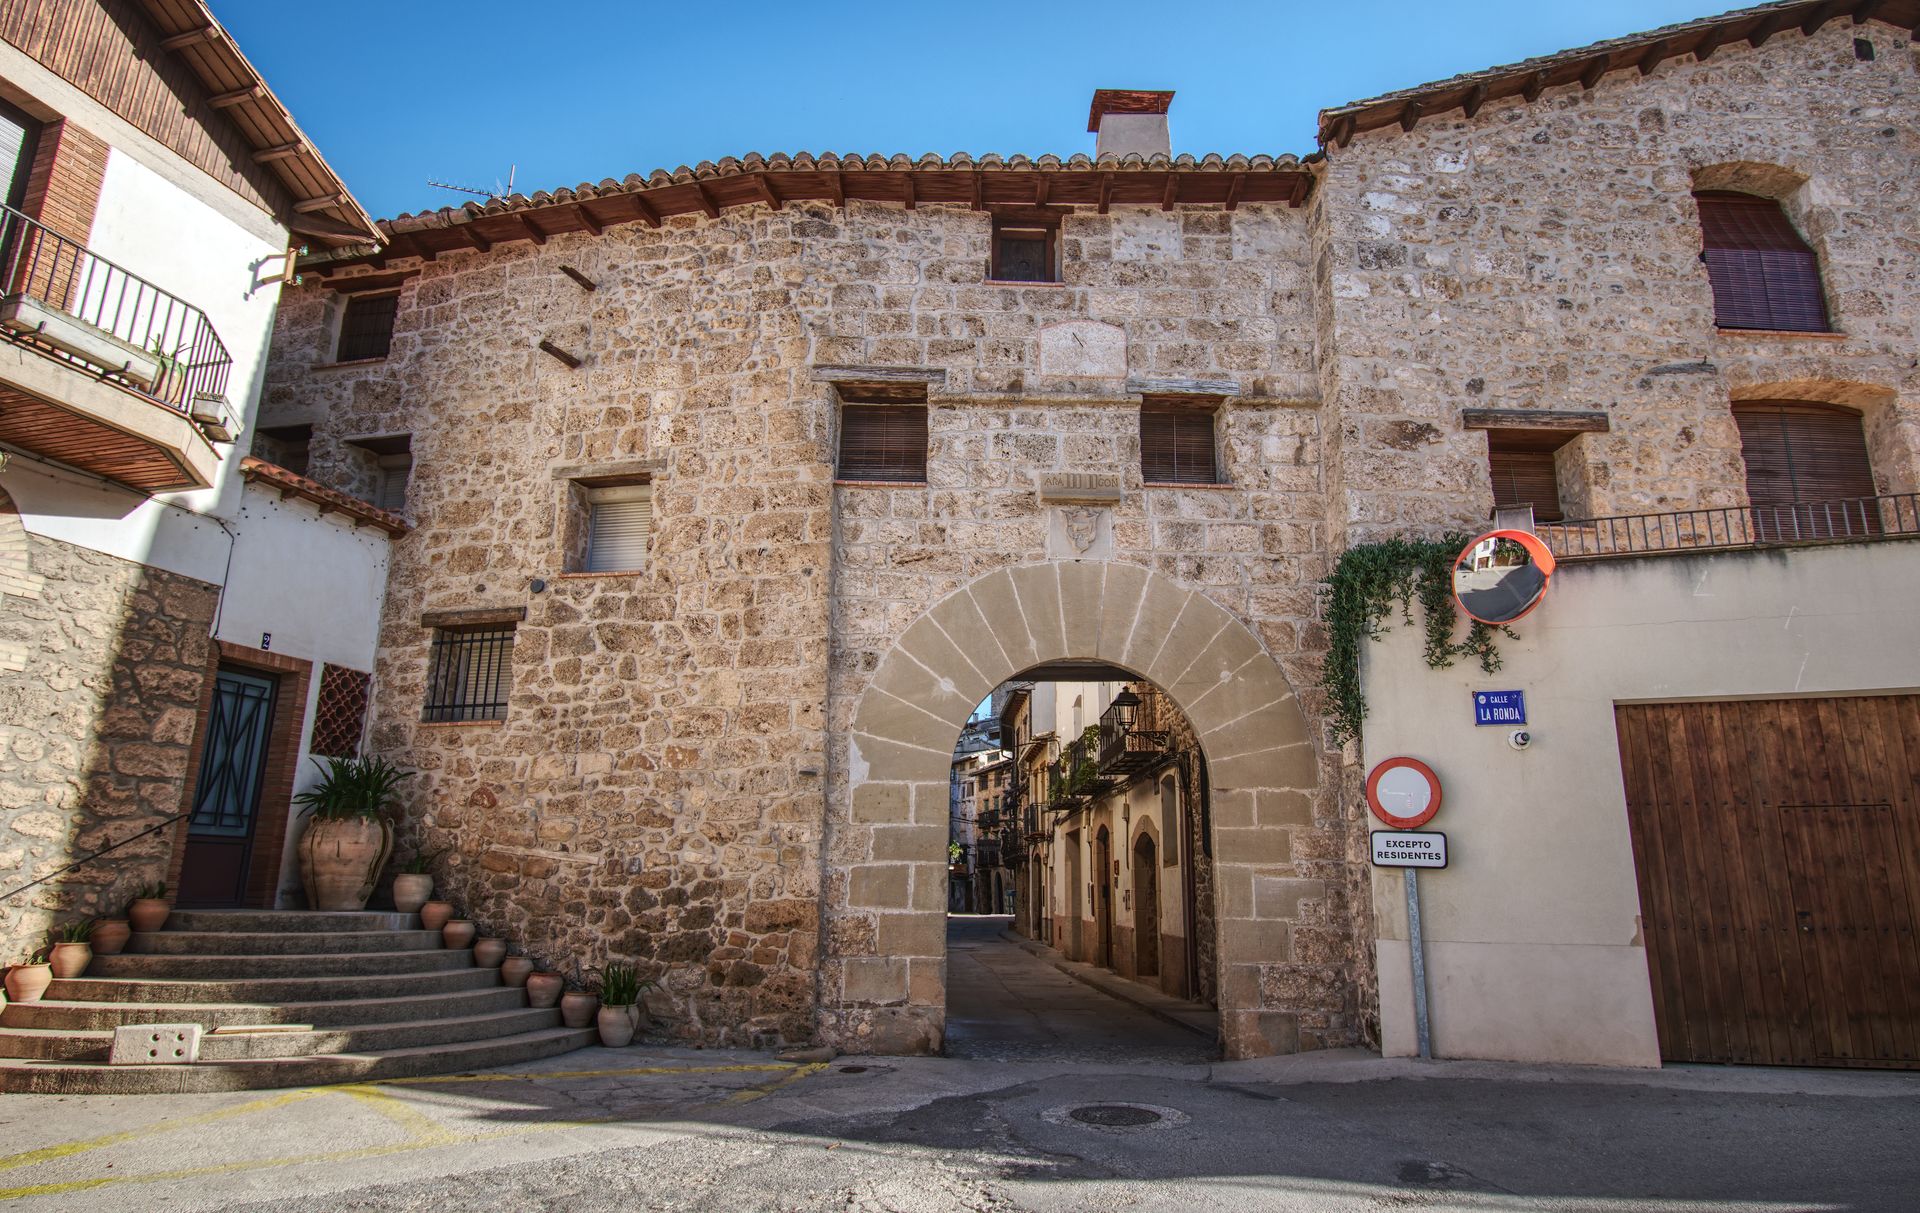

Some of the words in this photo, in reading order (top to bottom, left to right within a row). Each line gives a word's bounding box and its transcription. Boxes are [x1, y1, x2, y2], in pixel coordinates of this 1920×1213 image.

[263, 635, 270, 648] 2
[1490, 695, 1508, 704] CALLE
[1480, 707, 1492, 721] LA
[1493, 707, 1521, 721] RONDA
[1386, 840, 1431, 849] EXCEPTO
[1377, 851, 1441, 861] RESIDENTES
